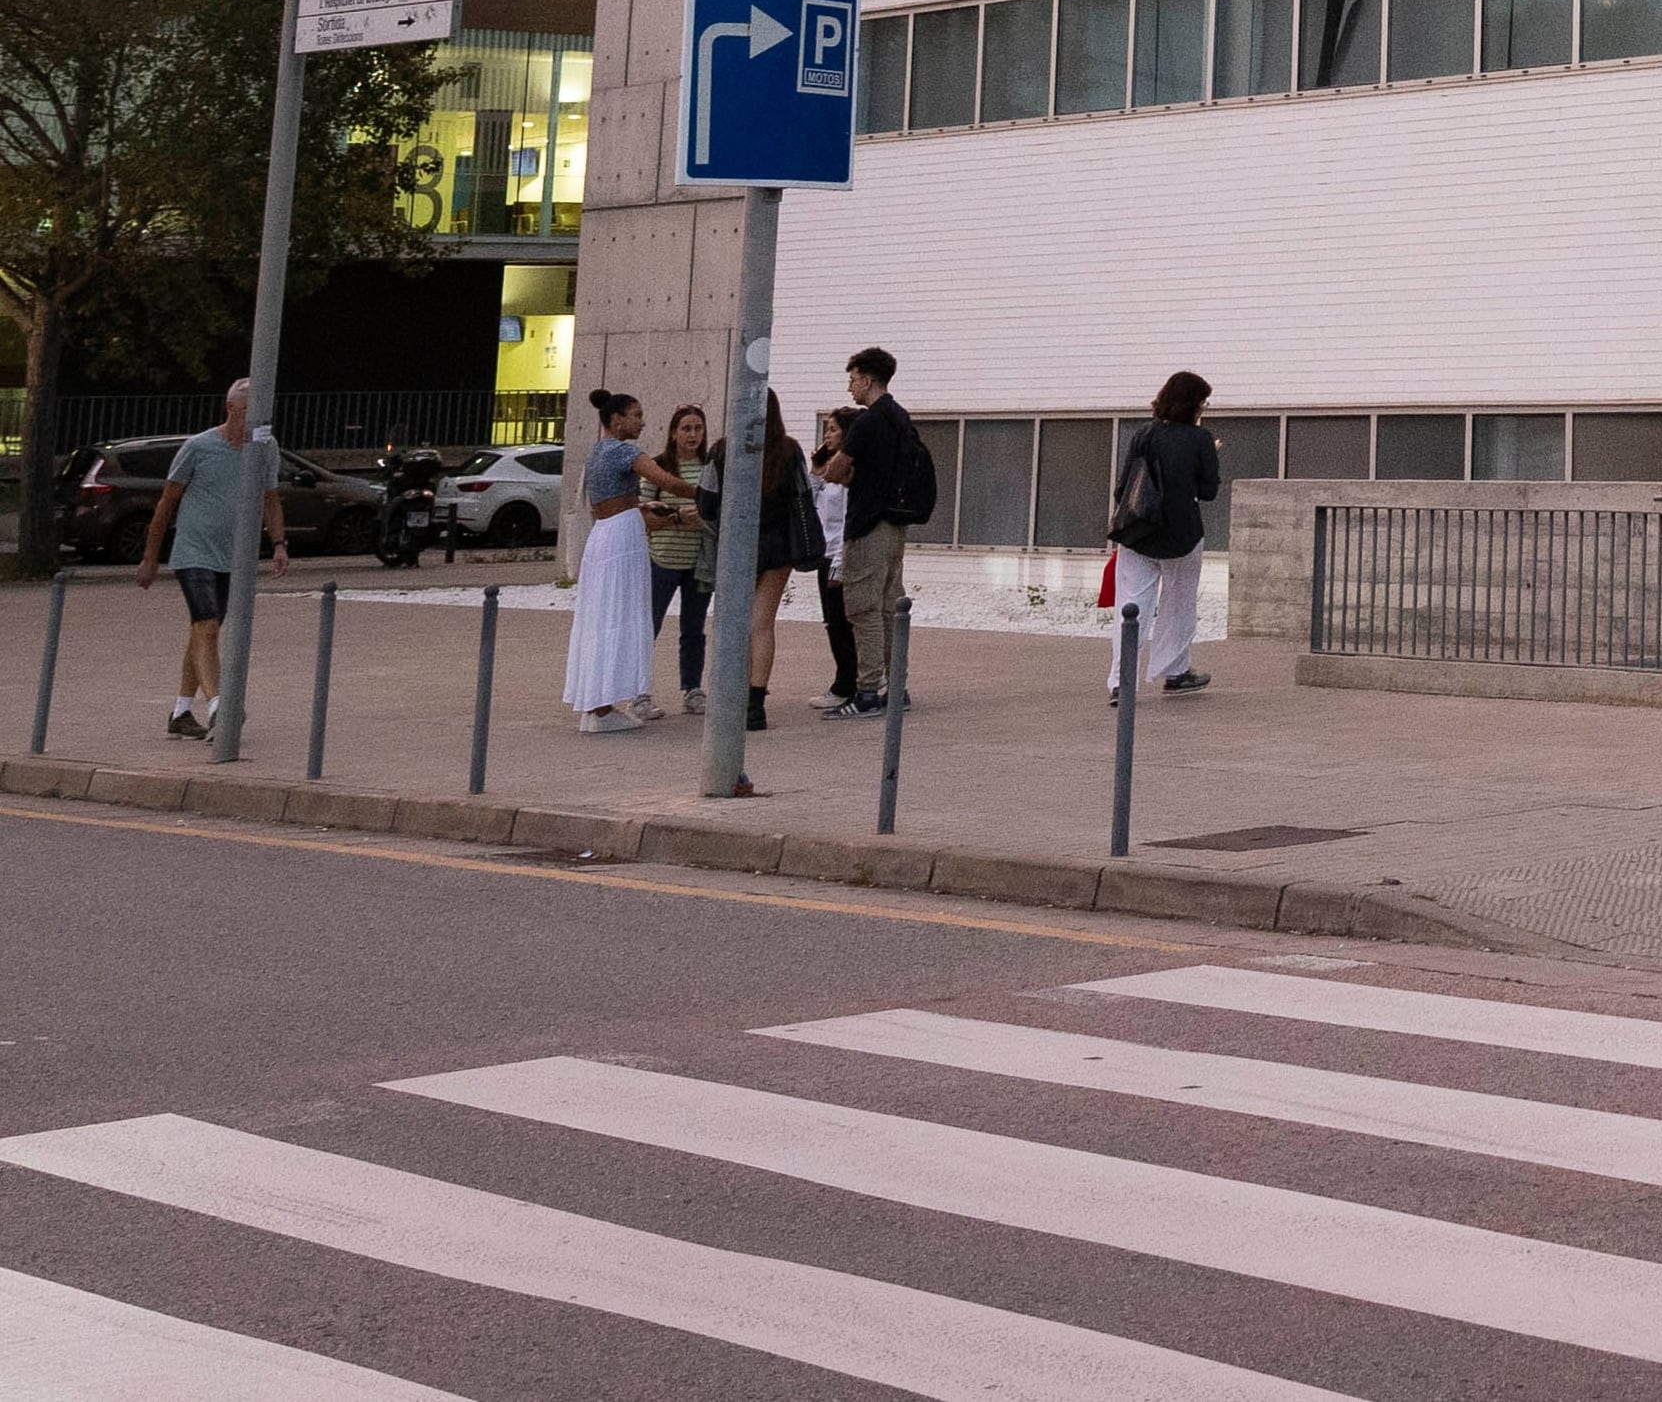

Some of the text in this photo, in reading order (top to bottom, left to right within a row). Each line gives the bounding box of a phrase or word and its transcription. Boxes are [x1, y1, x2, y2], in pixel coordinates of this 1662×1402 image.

[318, 15, 345, 32] Sortida
[815, 15, 842, 64] P
[808, 71, 841, 85] MOTOS
